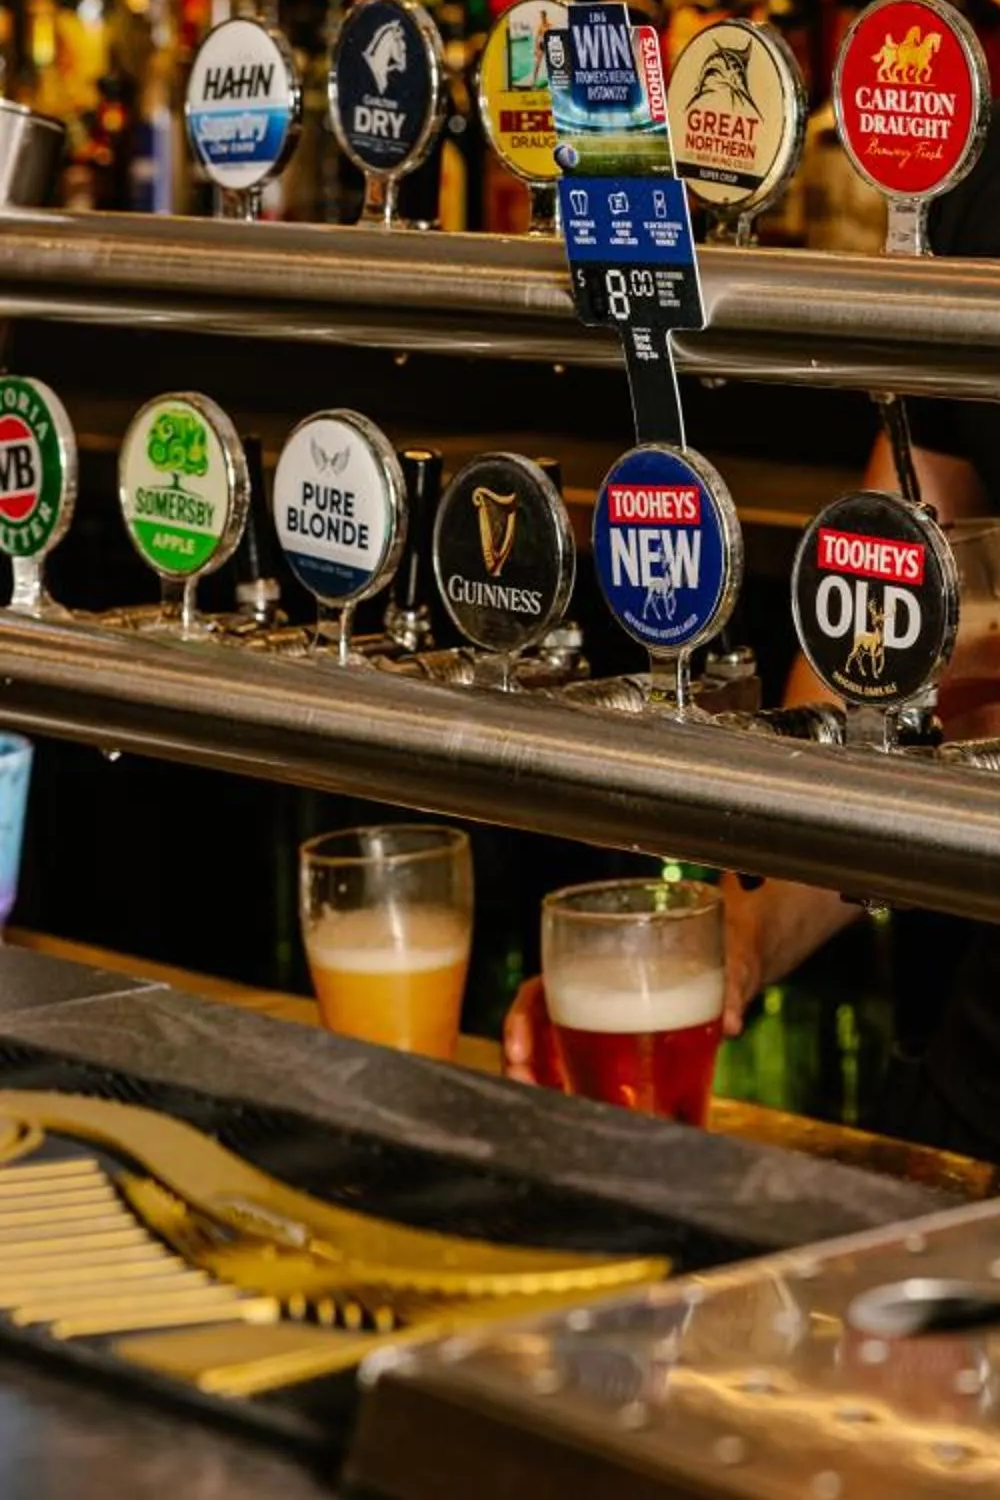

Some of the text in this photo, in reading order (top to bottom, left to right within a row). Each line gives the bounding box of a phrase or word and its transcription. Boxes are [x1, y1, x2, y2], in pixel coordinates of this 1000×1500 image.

[572, 23, 634, 69] WIN
[203, 63, 275, 101] HAHN
[643, 36, 666, 120] TOOHEYS
[855, 86, 956, 117] CARLTON
[354, 105, 407, 139] DRY
[687, 108, 759, 141] GREAT
[860, 112, 951, 140] DRAUGHT
[511, 135, 557, 149] DRAUG
[685, 133, 757, 160] NORTHERN
[0, 387, 49, 441] ORIA
[135, 487, 215, 527] SOMERSBY
[302, 482, 355, 517] PURE
[611, 489, 697, 520] TOOHEYS
[0, 502, 53, 548] TTER
[152, 531, 196, 556] APPLE
[286, 508, 369, 550] BLONDE
[609, 527, 701, 590] NEW
[823, 535, 920, 579] TOOHEYS
[449, 575, 543, 615] GUINNESS
[815, 575, 922, 650] OLD
